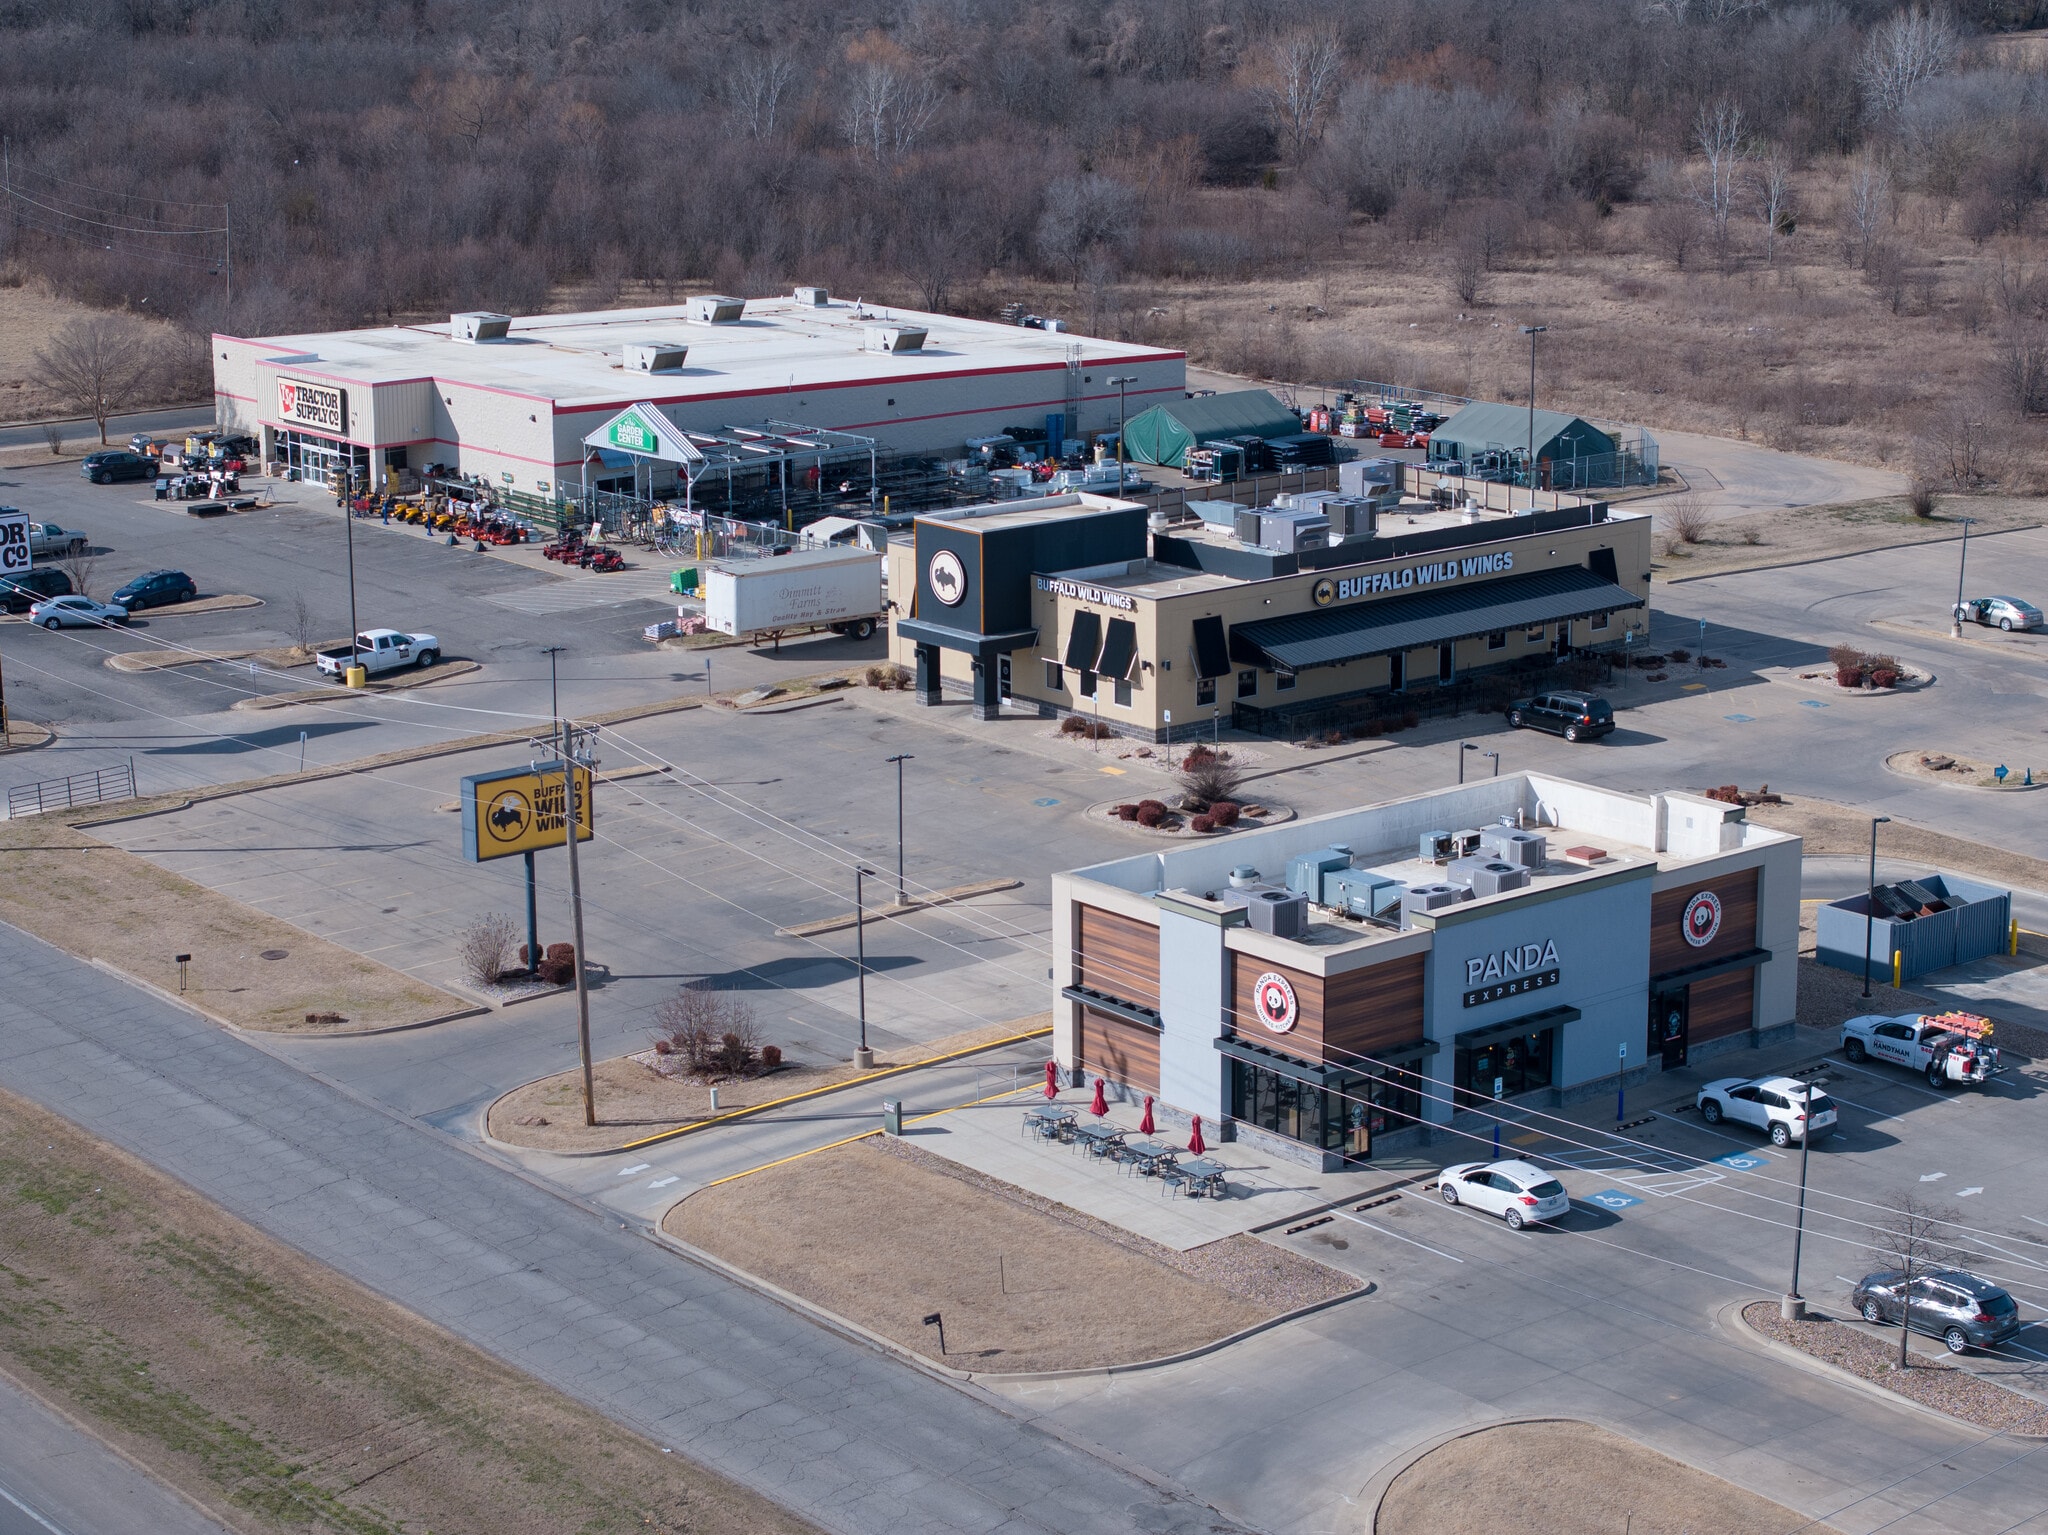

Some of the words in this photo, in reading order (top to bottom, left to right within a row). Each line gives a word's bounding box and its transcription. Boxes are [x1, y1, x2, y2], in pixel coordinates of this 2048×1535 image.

[296, 386, 338, 409] TRACTOR
[296, 403, 328, 424] SUPPLY
[617, 424, 643, 437] GARDEN
[617, 432, 643, 447] CENTER
[1339, 568, 1413, 599] BUFFALO
[1416, 562, 1458, 585] WILD
[1462, 552, 1513, 577] WINGS
[779, 586, 821, 599] Dimmitt
[790, 598, 821, 609] Farms
[1037, 579, 1076, 597] BUFFALO
[1077, 586, 1101, 603] WILD
[1102, 591, 1132, 609] WINGS
[772, 613, 797, 622] Quality
[825, 607, 847, 615] Straw
[1685, 896, 1700, 920] PANDA
[1701, 893, 1720, 912] EXPRESS
[1466, 939, 1559, 986] PANDA
[1256, 975, 1271, 993] PANDA
[1273, 974, 1294, 1005] EXPRESS
[1469, 973, 1556, 1004] EXPRESS
[1873, 1041, 1910, 1057] HANDYMAN
